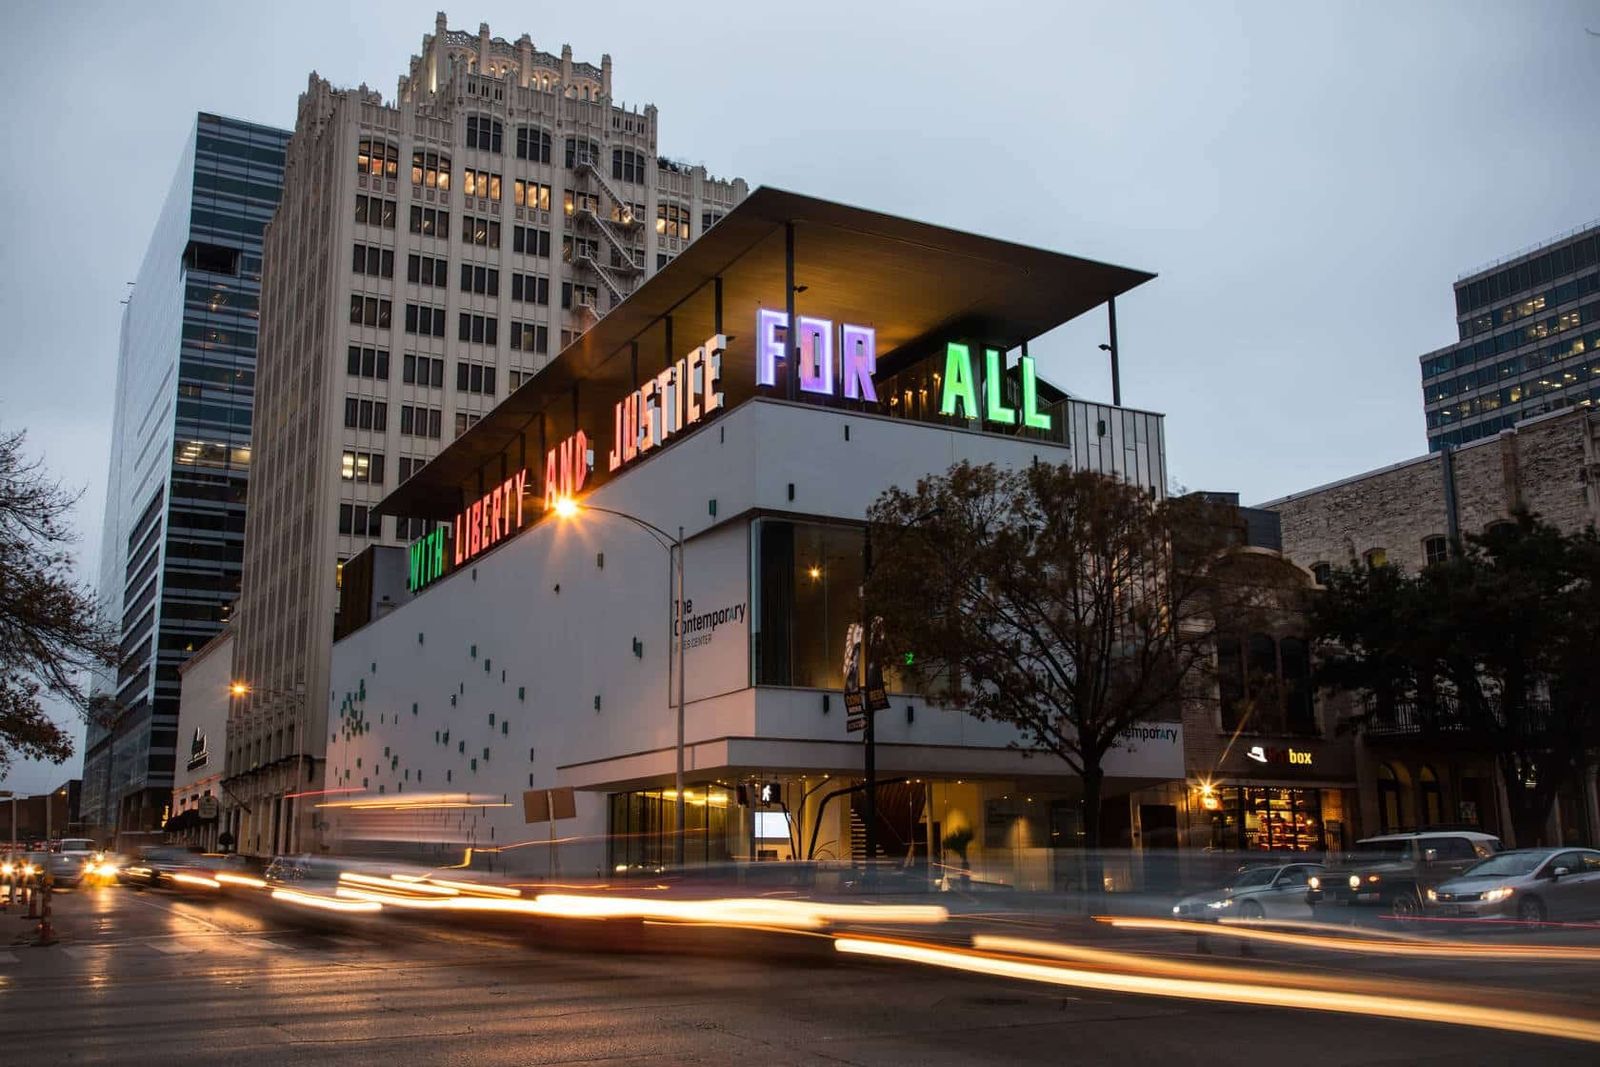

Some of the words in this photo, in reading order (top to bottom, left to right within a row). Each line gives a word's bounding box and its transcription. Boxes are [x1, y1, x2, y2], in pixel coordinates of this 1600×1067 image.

[409, 526, 444, 593] WITH
[454, 469, 527, 566] LIBERTY
[544, 429, 588, 512] AND
[609, 333, 727, 472] JUSTICE
[756, 308, 878, 402] FOR
[939, 341, 1051, 430] ALL
